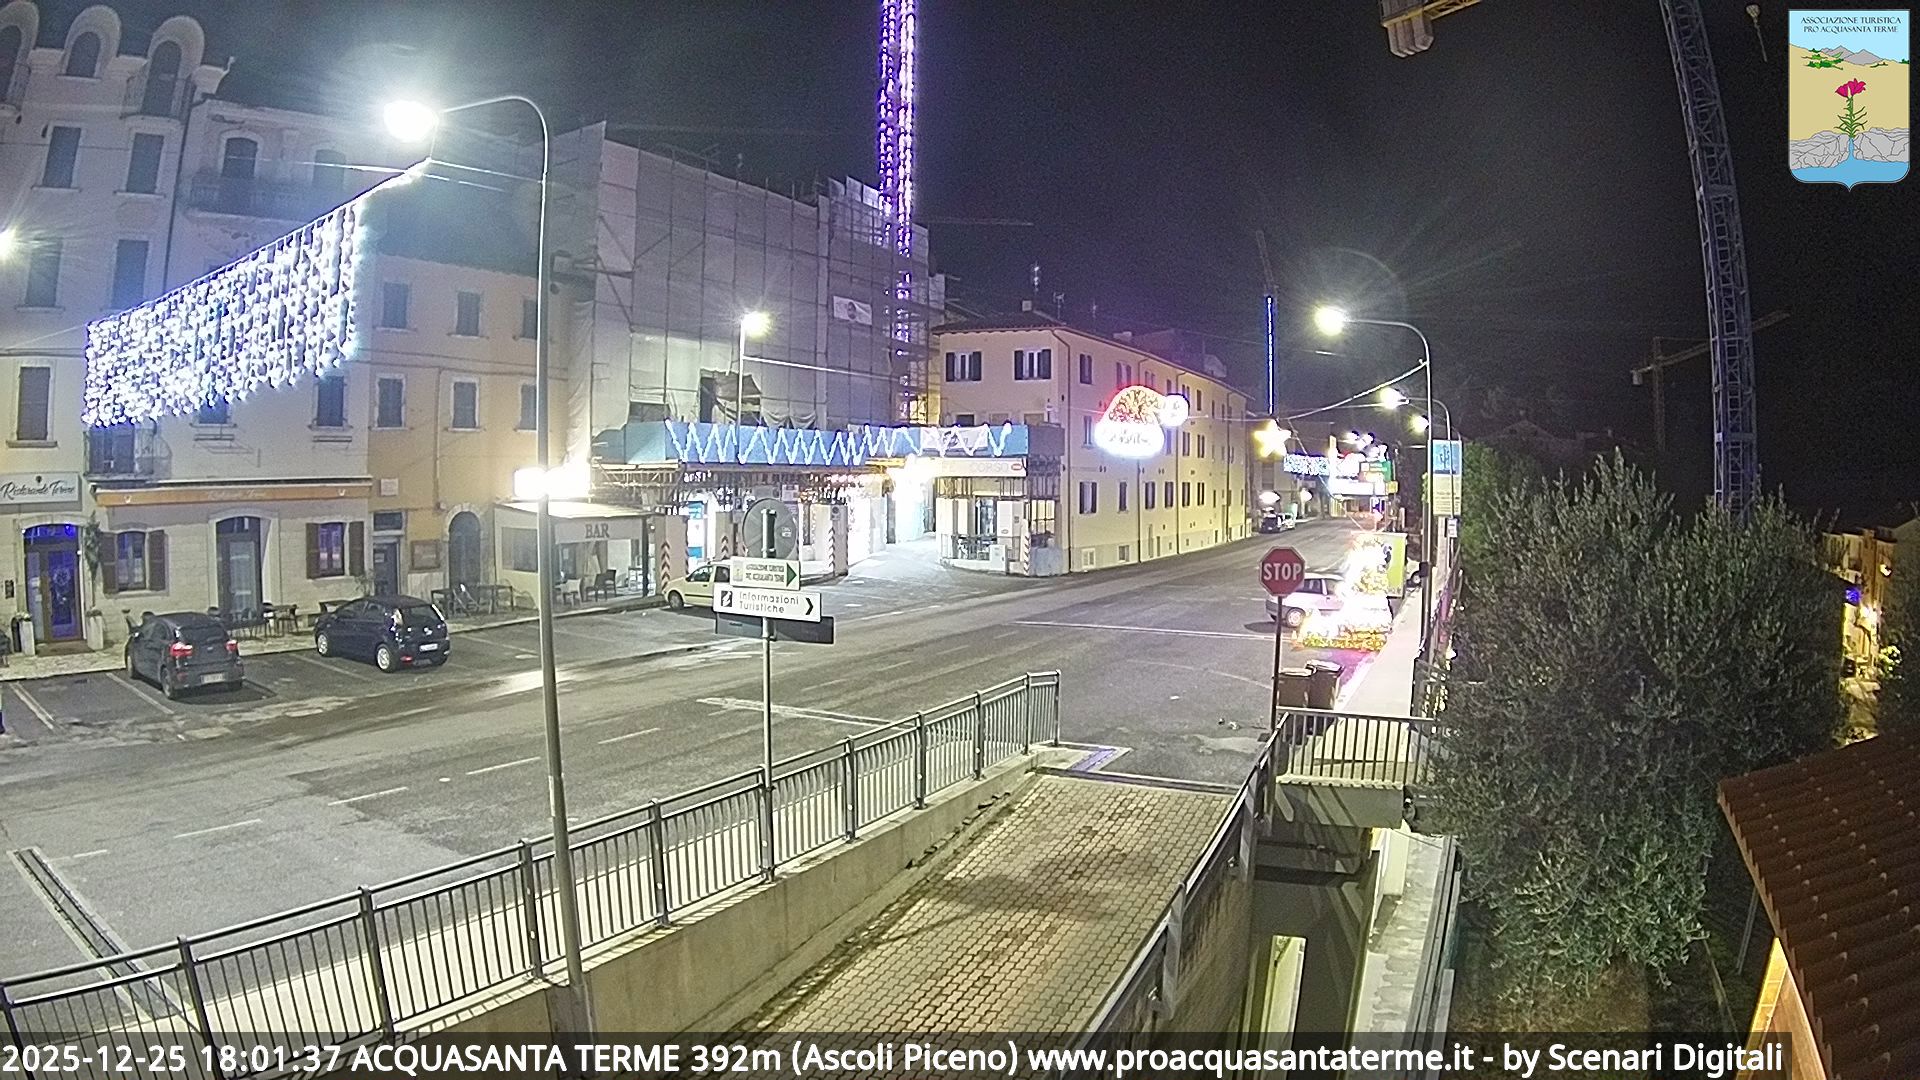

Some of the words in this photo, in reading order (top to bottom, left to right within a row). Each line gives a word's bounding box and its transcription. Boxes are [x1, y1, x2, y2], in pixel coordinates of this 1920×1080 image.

[0, 481, 49, 500] Ristorante
[49, 480, 75, 496] Terme
[585, 523, 610, 538] BAR
[1263, 563, 1302, 581] STOP
[739, 591, 800, 606] Informazioni
[739, 600, 785, 614] Turistiche
